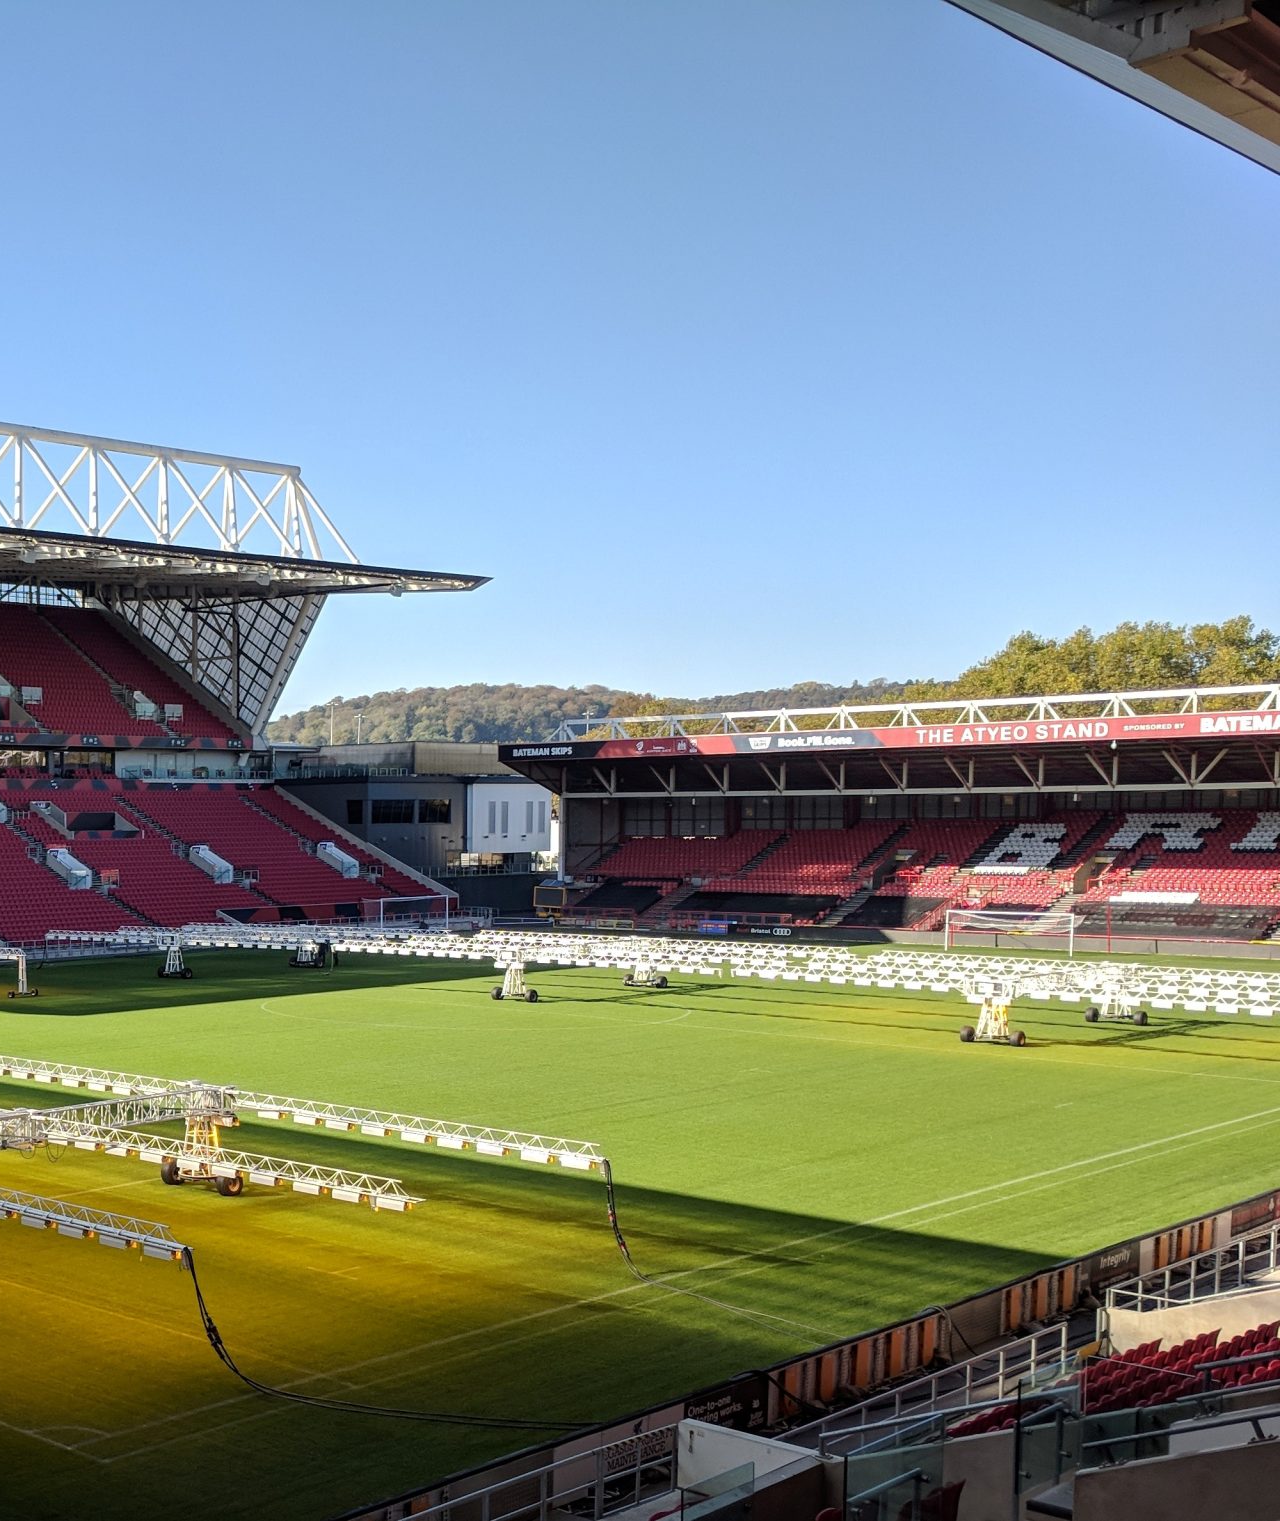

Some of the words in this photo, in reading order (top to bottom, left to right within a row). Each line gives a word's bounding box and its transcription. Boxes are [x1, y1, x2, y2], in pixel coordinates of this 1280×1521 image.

[915, 728, 954, 744] THE
[960, 725, 1028, 742] ATYEO
[1035, 721, 1109, 739] STAND
[1123, 723, 1172, 732] SPONSORED
[1173, 722, 1185, 730] BY
[512, 748, 550, 757] BATEMAN
[550, 746, 573, 756] SKIPS
[1100, 1248, 1131, 1269] Integrity
[687, 1395, 732, 1417] One-to-one
